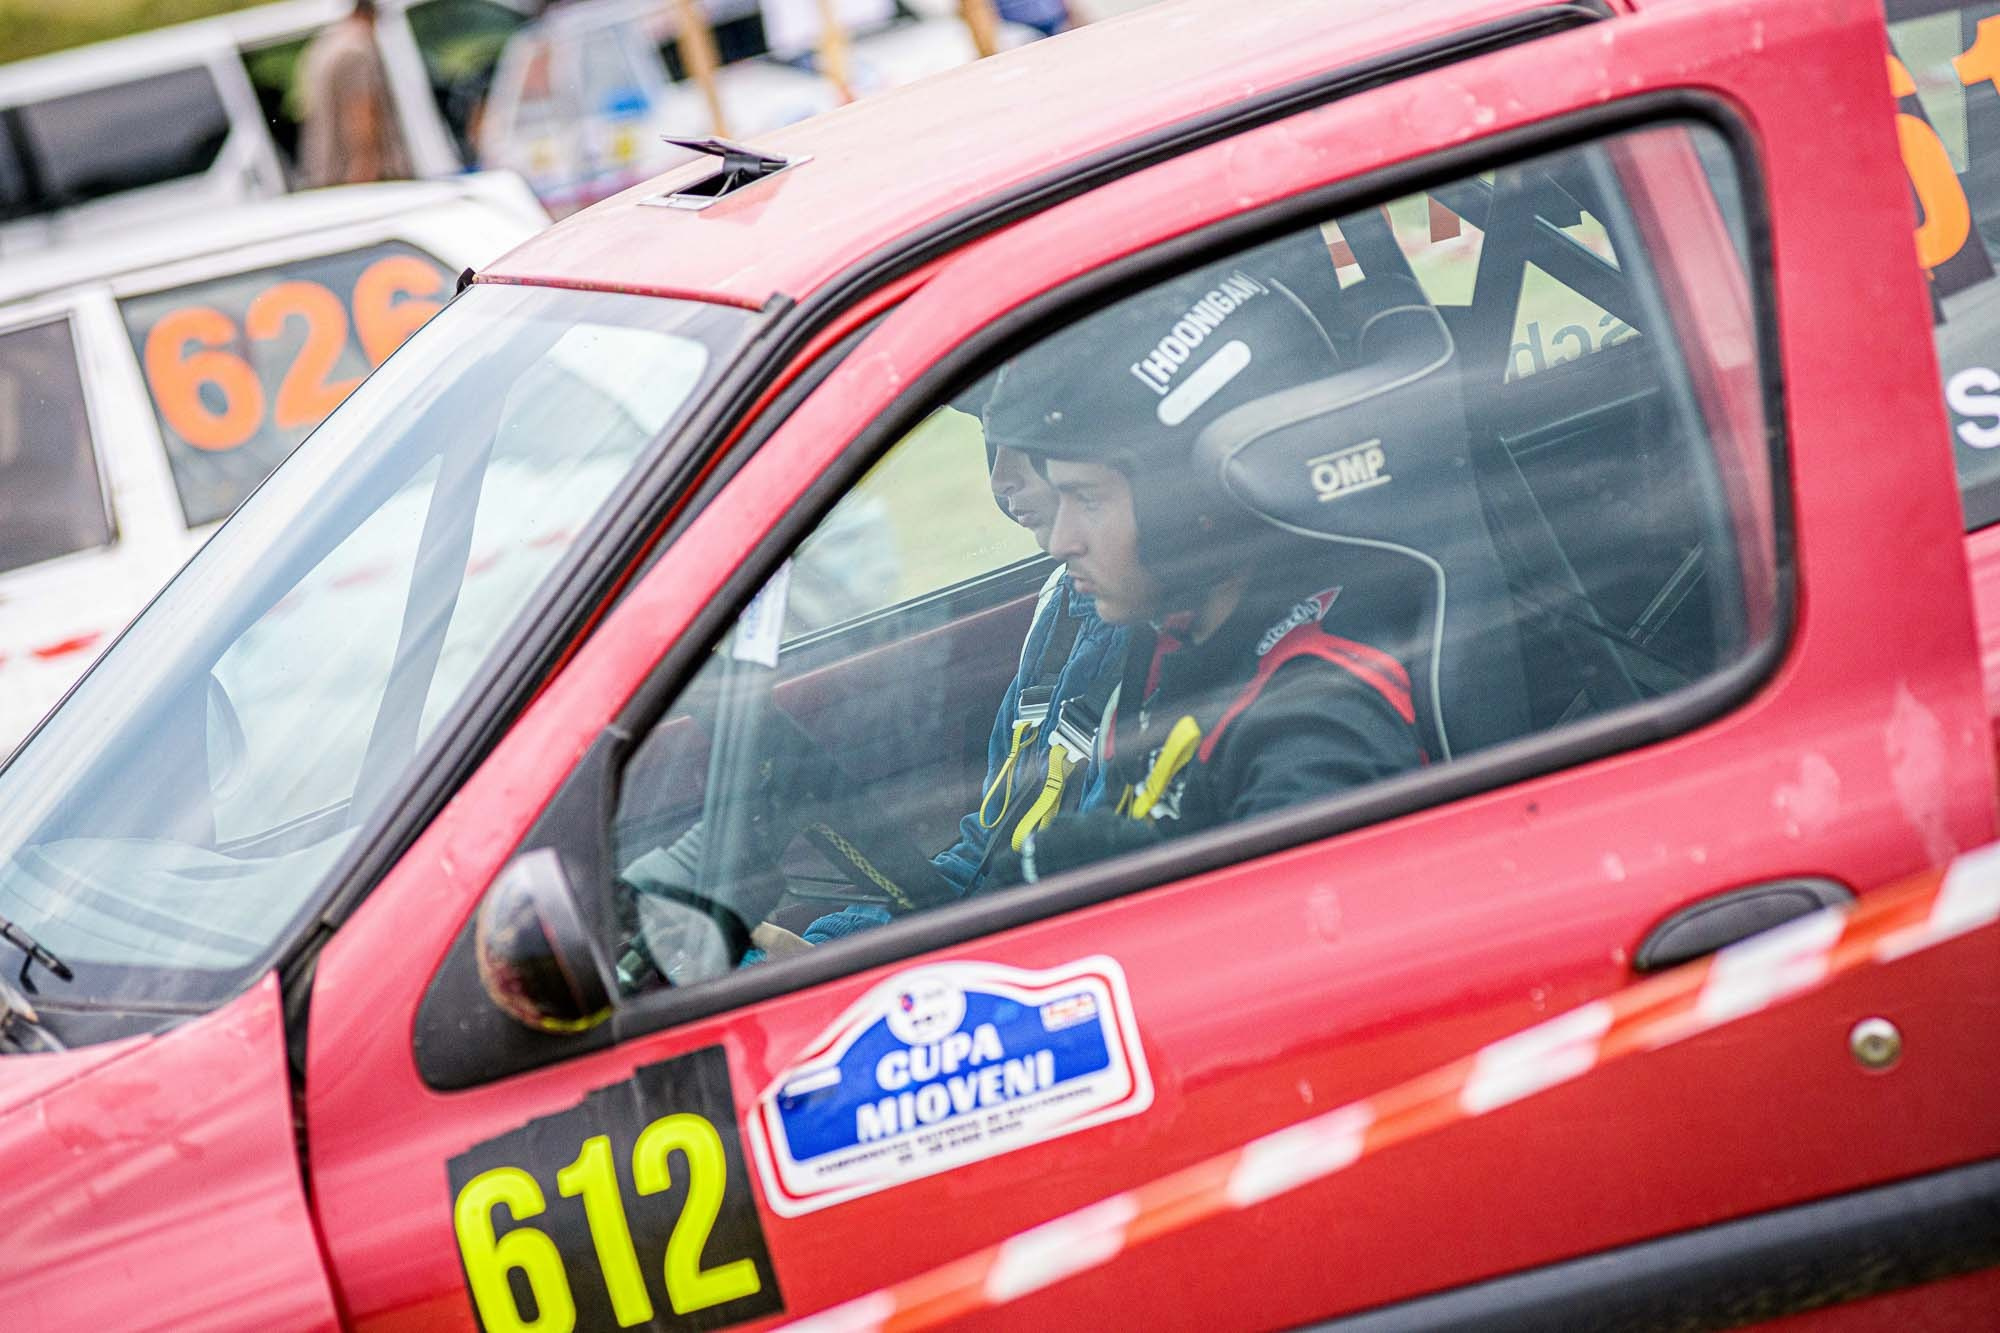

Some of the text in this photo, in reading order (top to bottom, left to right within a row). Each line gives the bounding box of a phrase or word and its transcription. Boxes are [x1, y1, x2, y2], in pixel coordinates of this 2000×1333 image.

[1311, 446, 1388, 495] OMP
[854, 1047, 1057, 1145] MIOVENI
[875, 1021, 1005, 1092] CUPA
[453, 1112, 762, 1333] 612
